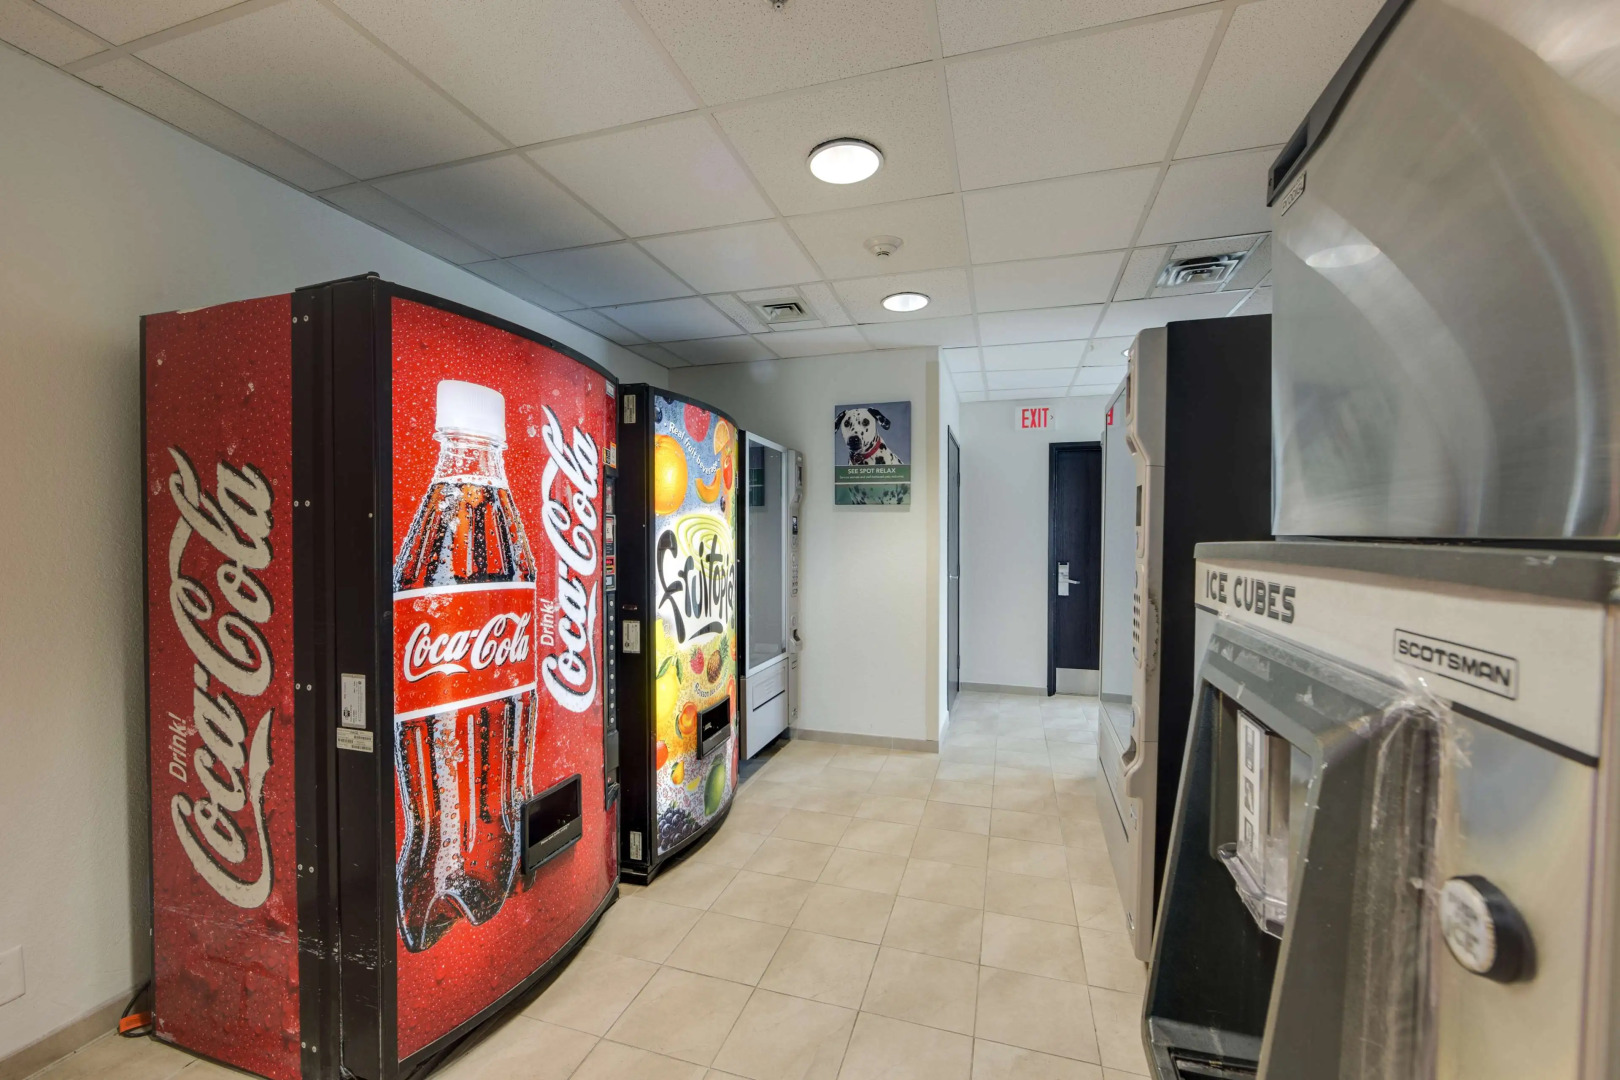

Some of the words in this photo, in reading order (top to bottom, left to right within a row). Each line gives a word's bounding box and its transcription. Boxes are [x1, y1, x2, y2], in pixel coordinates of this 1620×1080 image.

[1021, 407, 1050, 429] EXIT
[669, 421, 686, 441] Real
[684, 437, 698, 459] fruit
[697, 455, 718, 475] beverage
[541, 404, 599, 713] Coca-Cola
[540, 598, 555, 647] Drink!
[1206, 569, 1228, 604] ICE
[1233, 575, 1296, 624] CUBES
[403, 611, 532, 683] Coca-Cola
[1398, 638, 1511, 687] SCOTSMAN
[167, 444, 275, 909] Coca-Cola
[168, 711, 187, 783] Drink!
